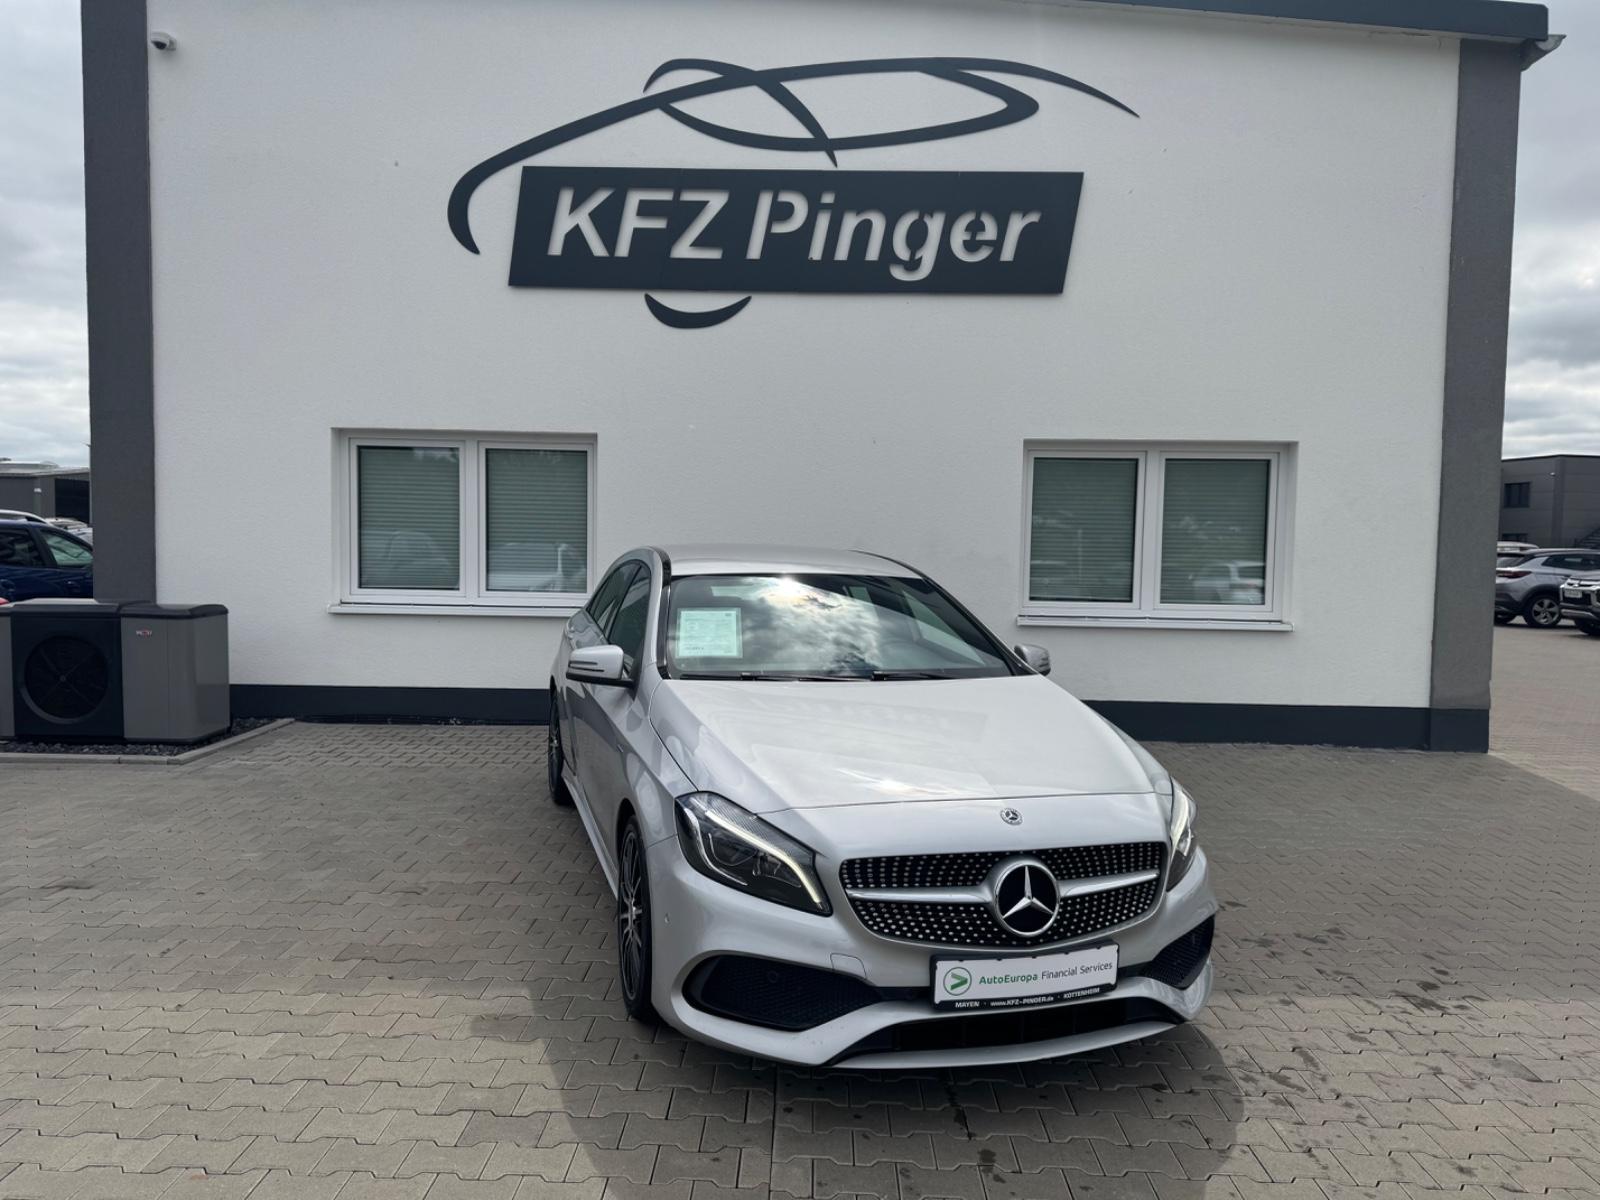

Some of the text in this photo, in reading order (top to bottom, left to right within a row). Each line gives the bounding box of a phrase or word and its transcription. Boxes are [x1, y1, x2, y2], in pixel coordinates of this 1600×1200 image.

[547, 187, 1042, 281] KFZ Pinger
[979, 962, 1113, 985] AutoEuropa Financial Services
